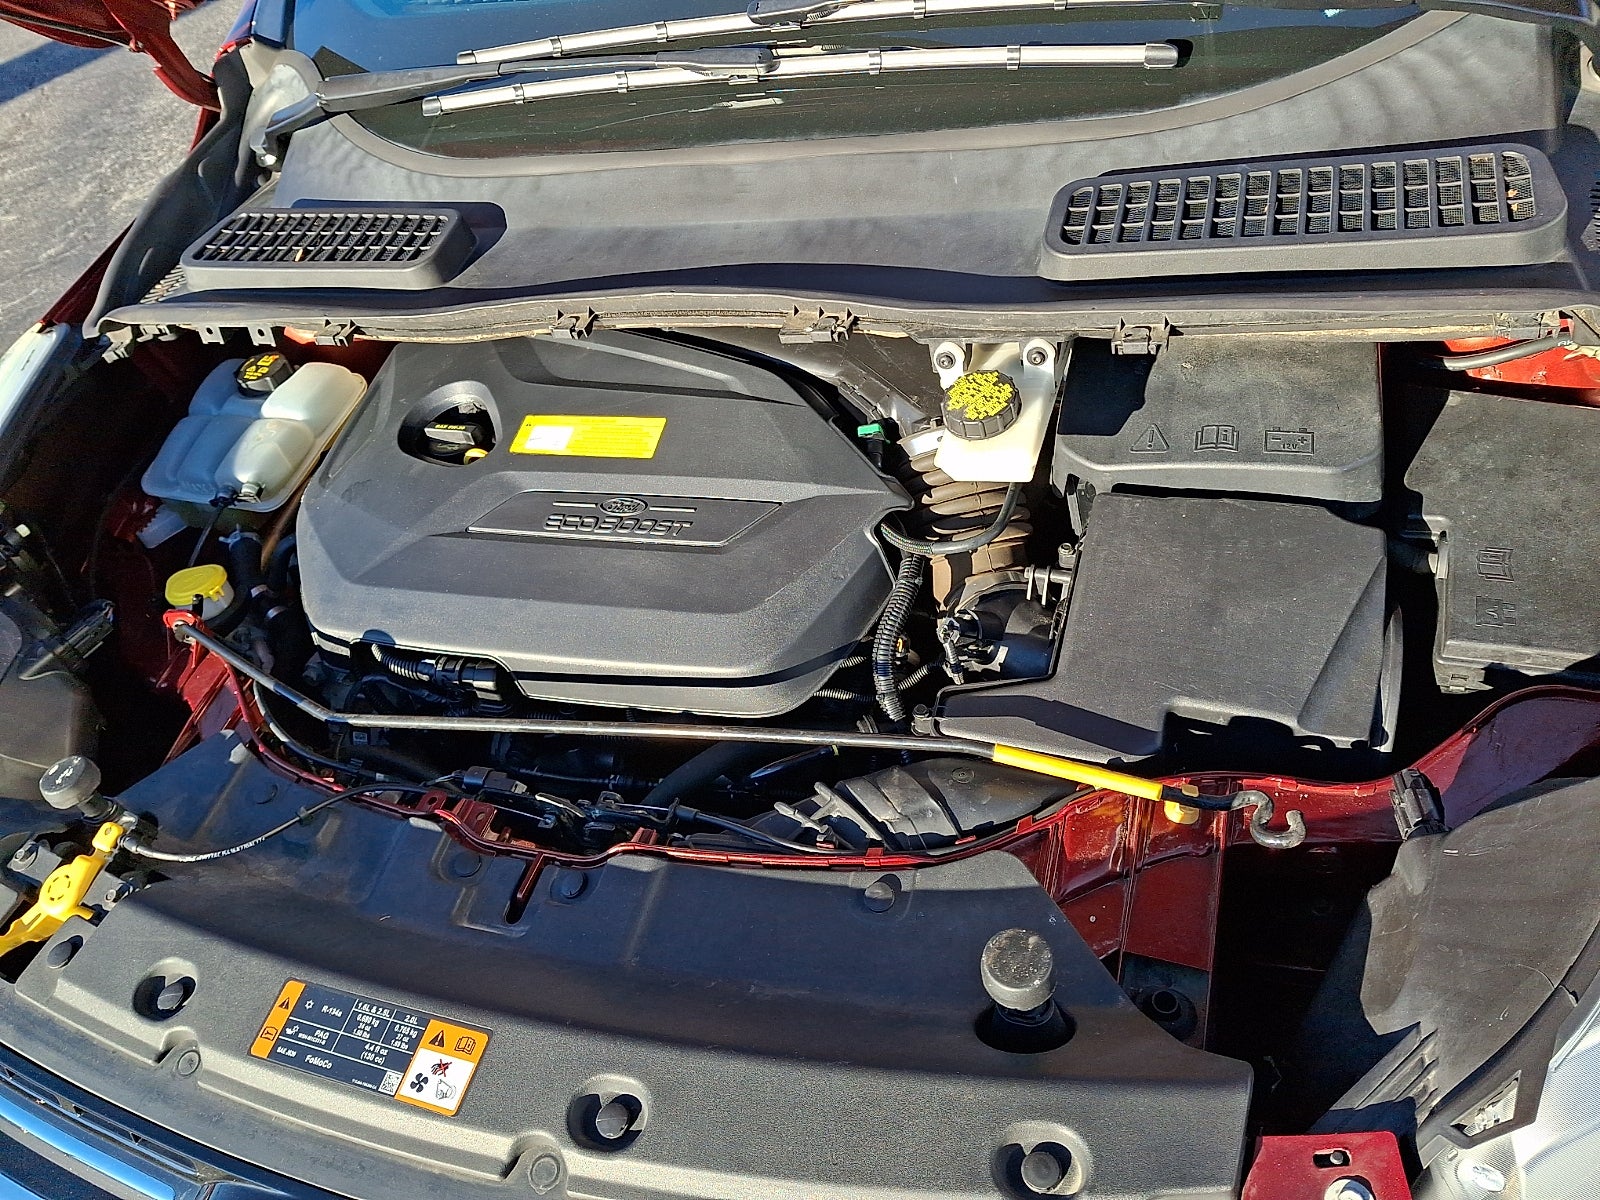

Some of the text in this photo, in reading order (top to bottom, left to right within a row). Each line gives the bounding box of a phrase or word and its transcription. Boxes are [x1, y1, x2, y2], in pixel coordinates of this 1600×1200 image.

[606, 499, 642, 513] Ford
[544, 513, 693, 536] ECOBOOST
[321, 1005, 343, 1018] R-134a
[357, 1002, 391, 1018] 1.6L & 2.5L
[371, 1018, 380, 1028] kg
[404, 1014, 418, 1025] 2.0L
[314, 1030, 330, 1040] PAG
[409, 1029, 418, 1039] kg
[364, 1043, 389, 1056] 4.4 fl oz
[400, 1042, 409, 1050] lbs
[304, 1054, 333, 1069] FoMoCo
[360, 1051, 386, 1065] (130 cc)
